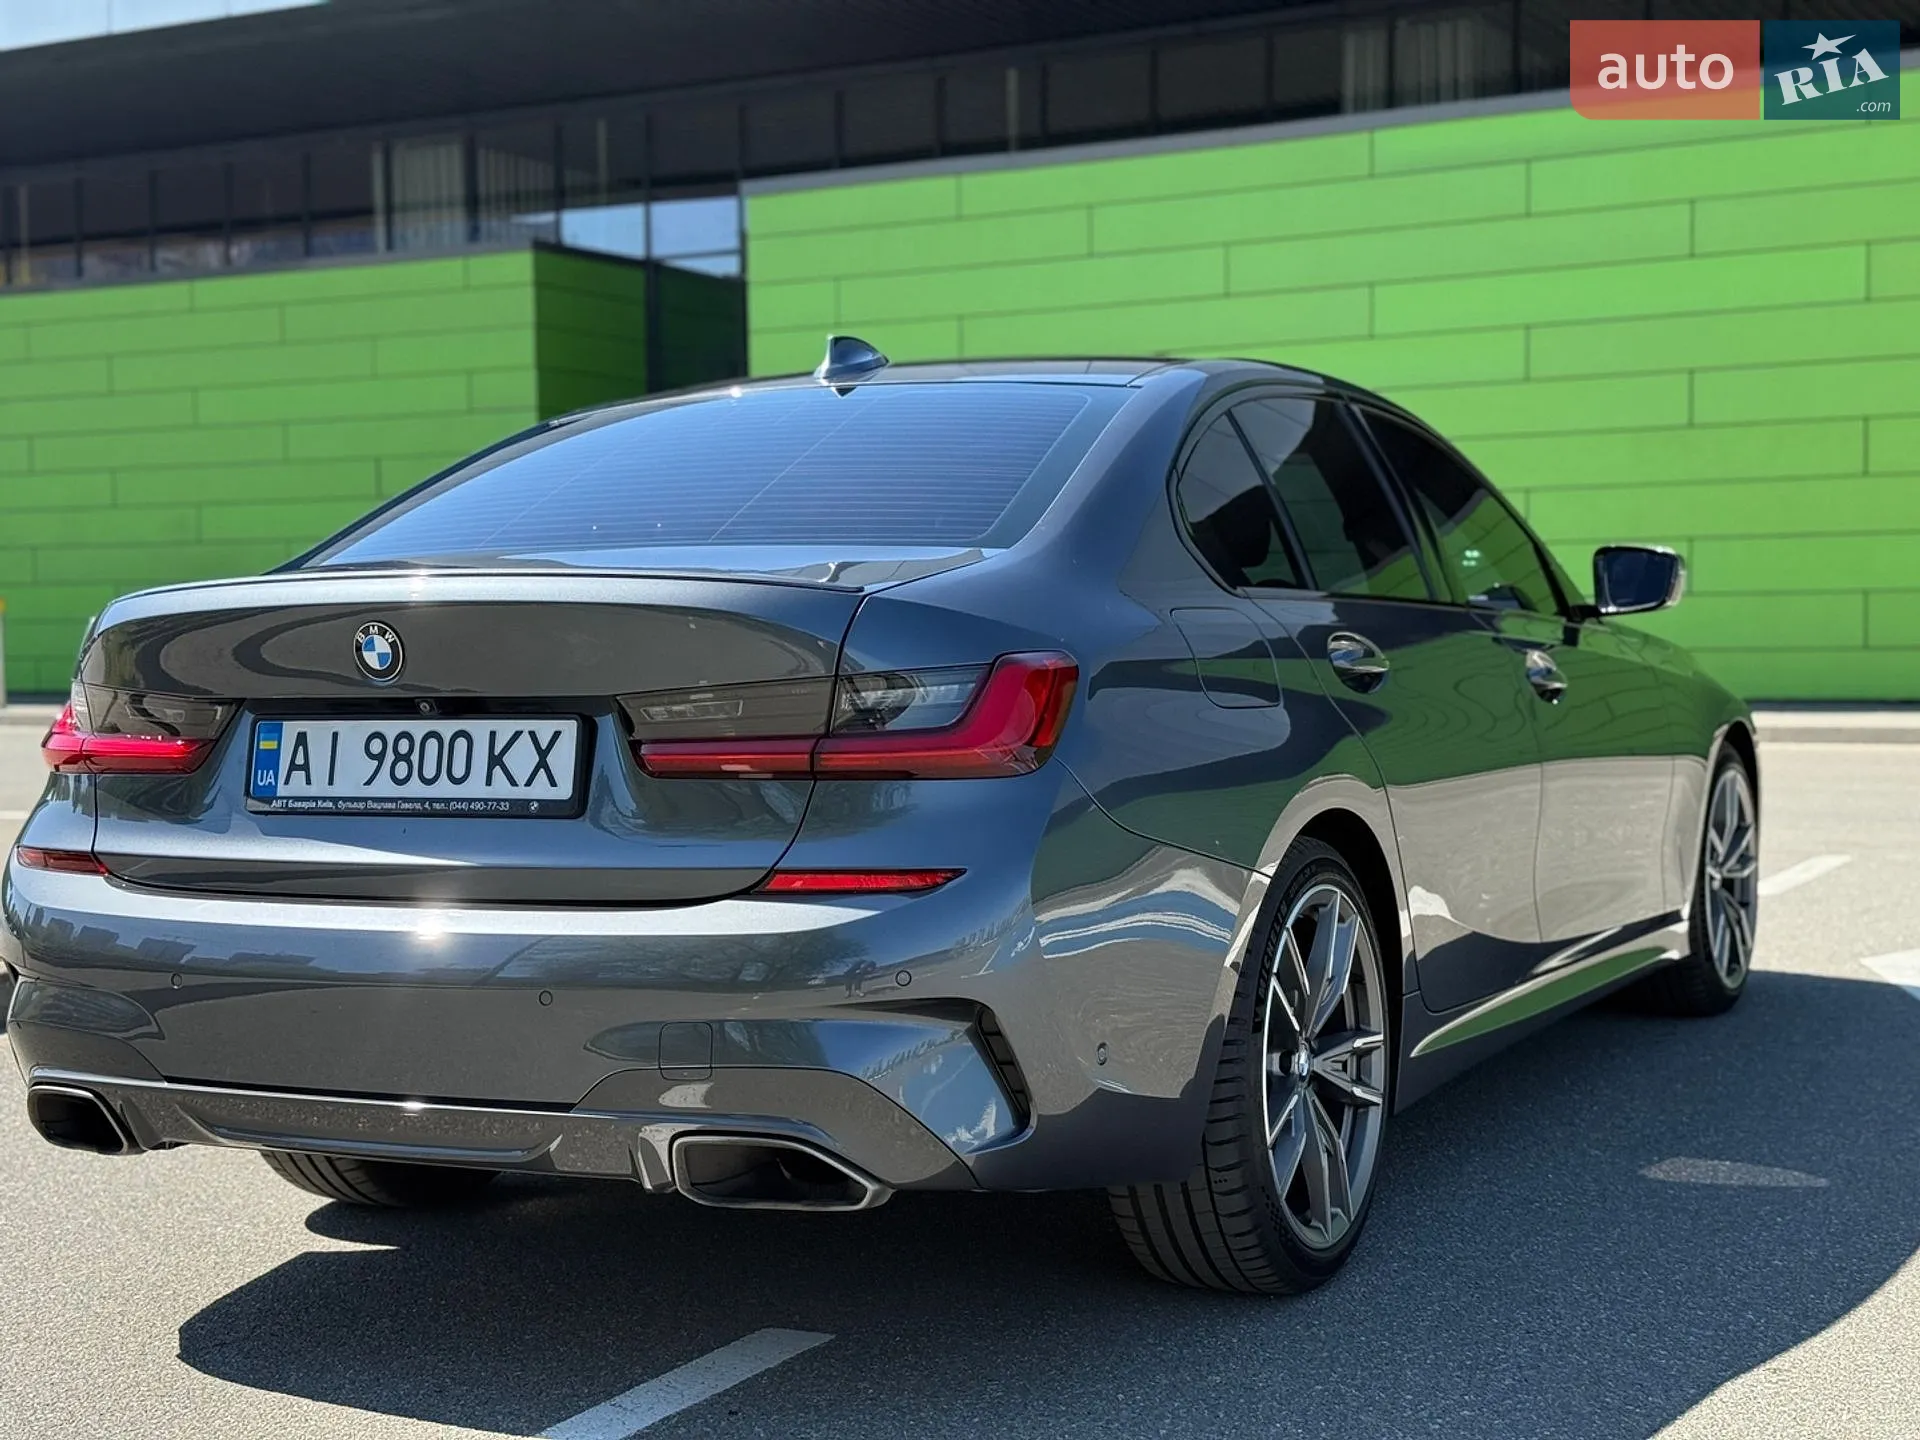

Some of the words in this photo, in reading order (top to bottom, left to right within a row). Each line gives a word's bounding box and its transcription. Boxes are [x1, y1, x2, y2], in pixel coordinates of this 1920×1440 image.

[358, 625, 395, 643] BMW
[284, 731, 338, 786] AI
[362, 730, 474, 786] 9800
[485, 730, 562, 788] KX
[257, 769, 276, 786] UA
[449, 801, 469, 811] (044)
[469, 801, 510, 812] 490-77-33
[1258, 899, 1288, 999] MICHELIN
